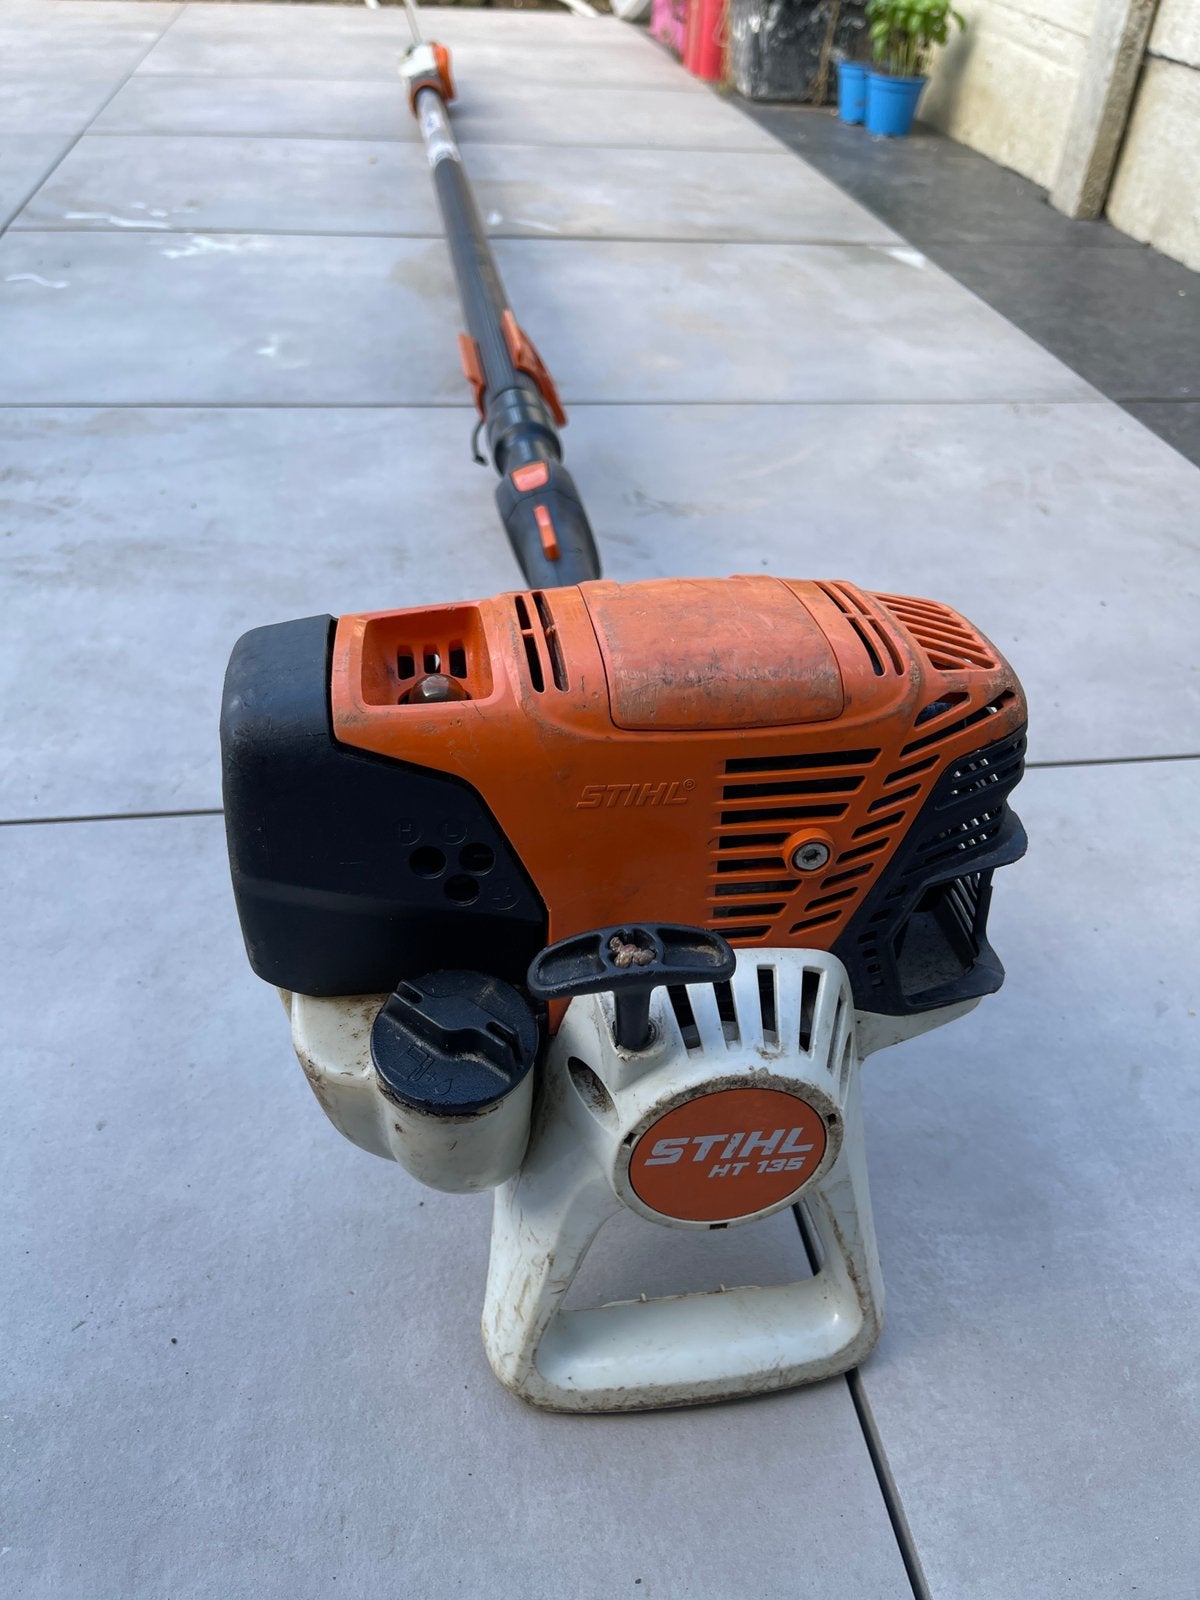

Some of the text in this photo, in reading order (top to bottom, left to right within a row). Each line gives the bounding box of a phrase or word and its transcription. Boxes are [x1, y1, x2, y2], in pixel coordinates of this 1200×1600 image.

[644, 1127, 814, 1166] STIHL
[708, 1157, 806, 1178] HT 135
